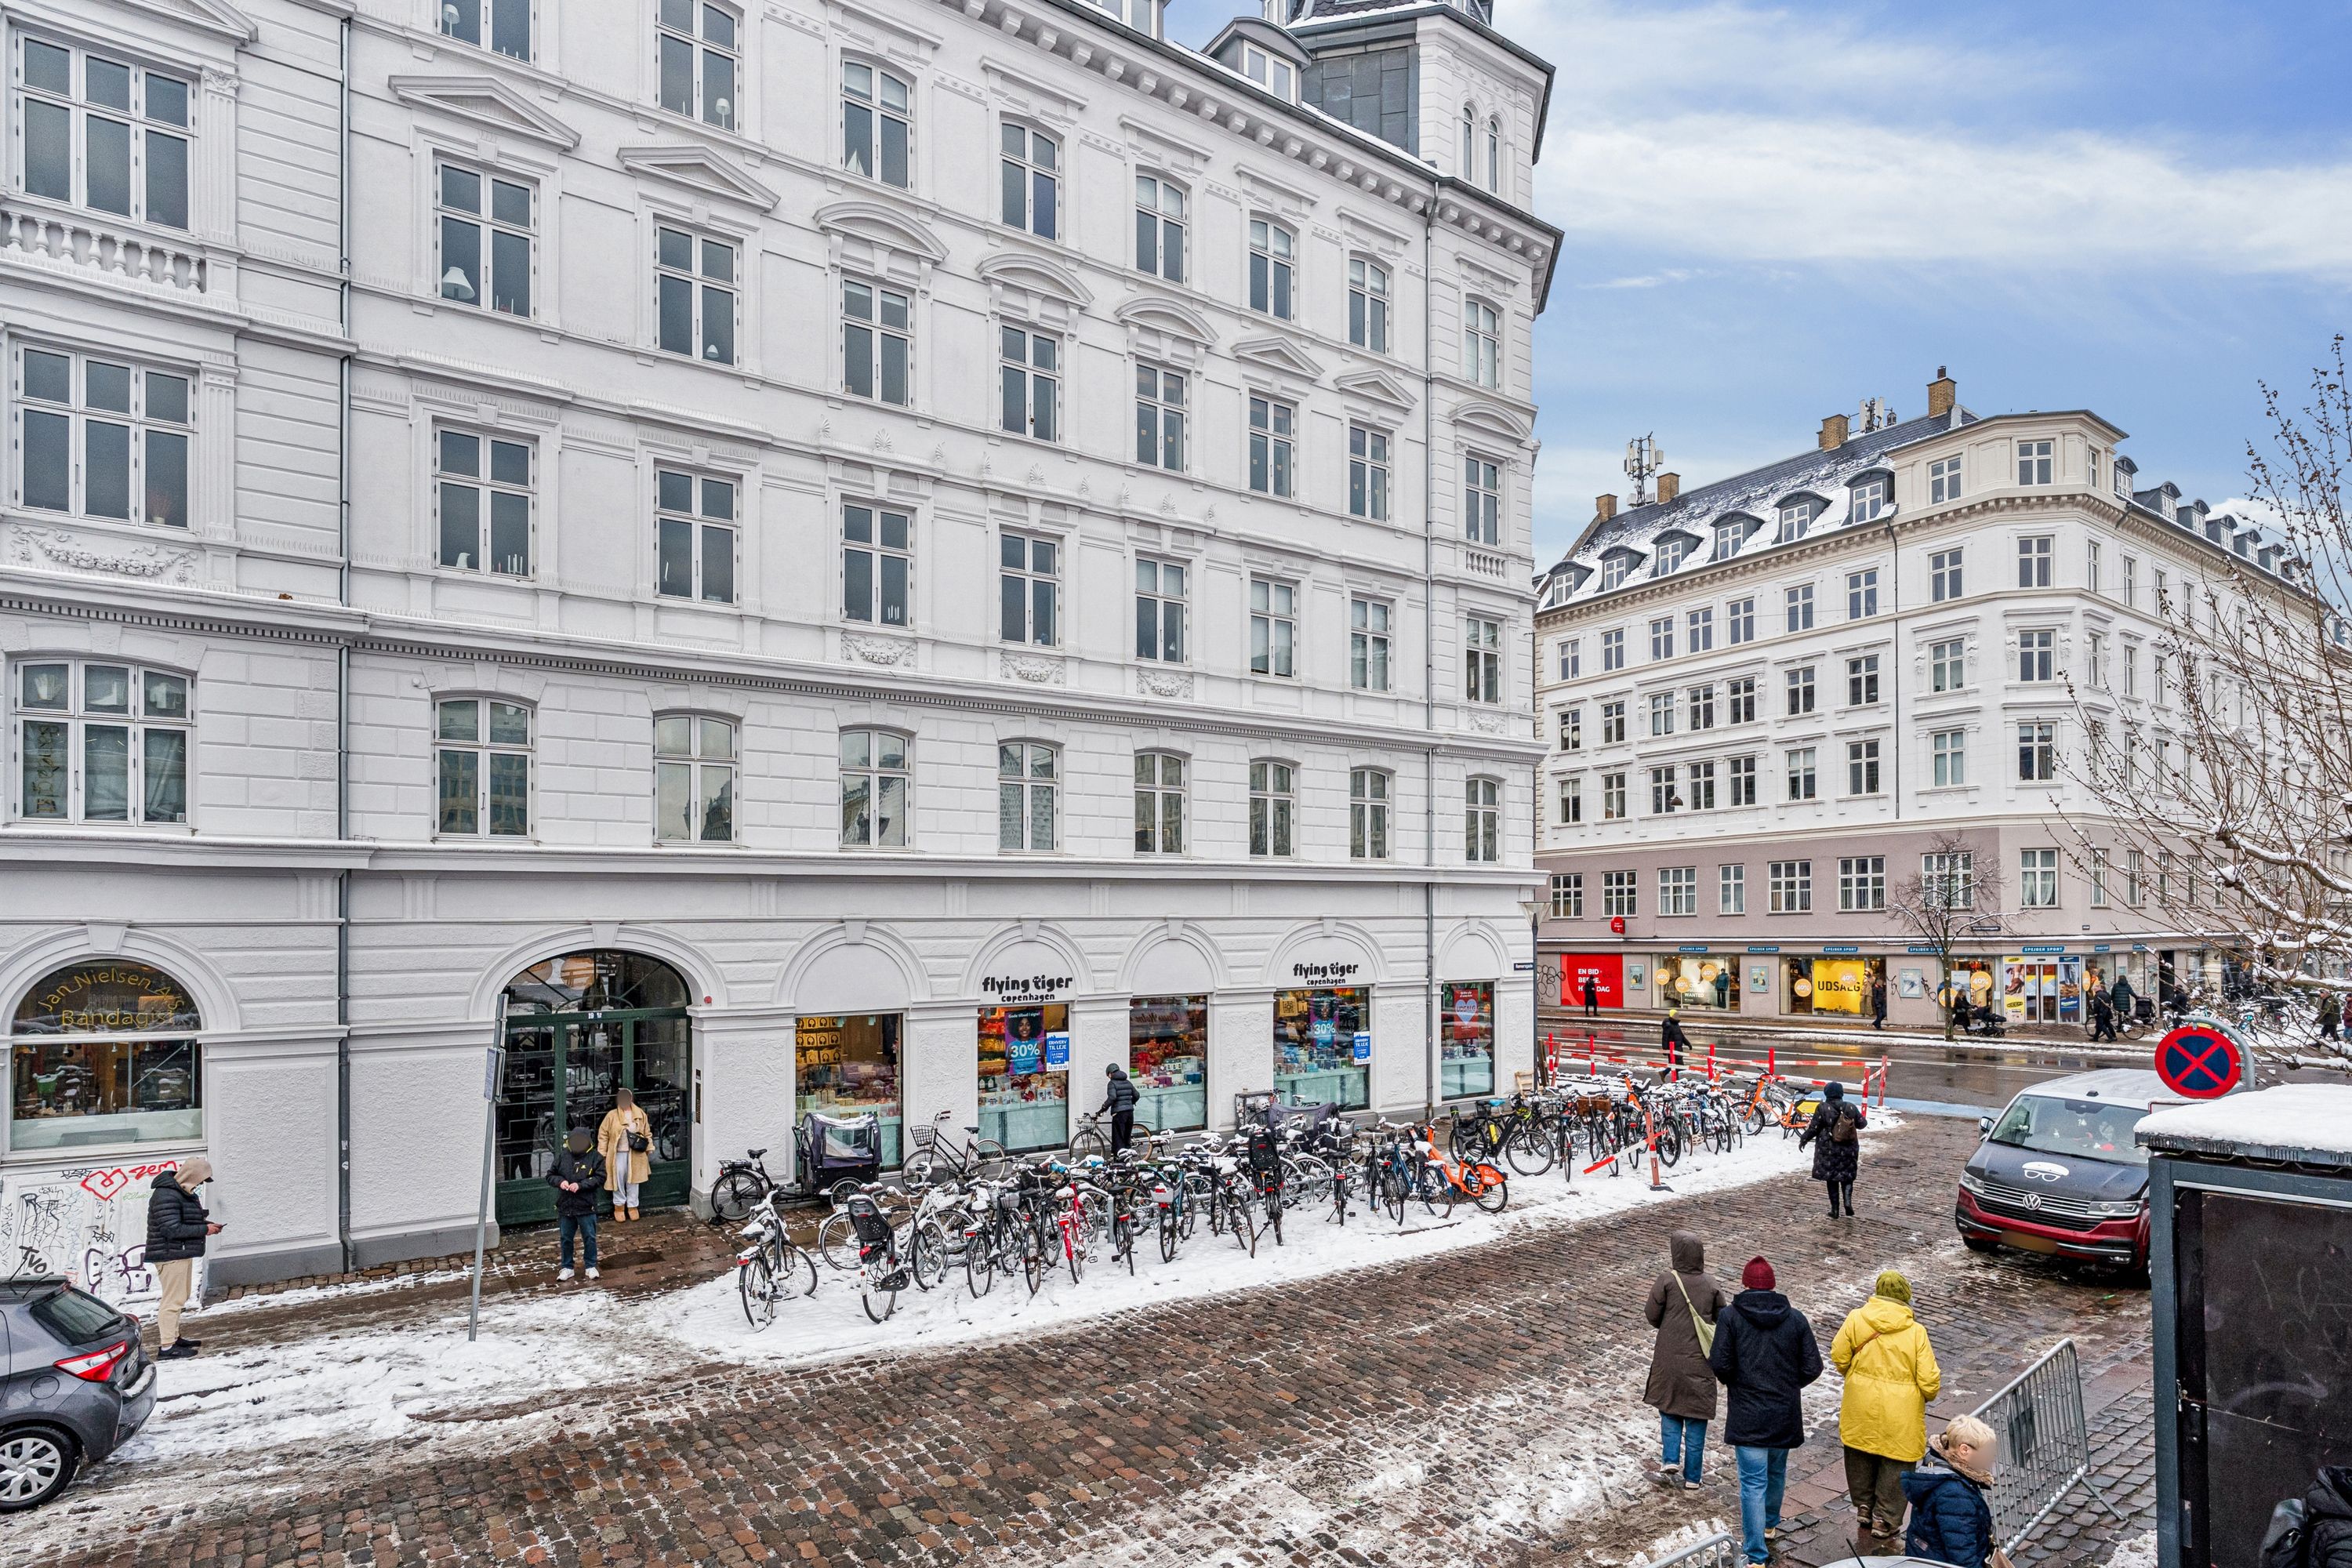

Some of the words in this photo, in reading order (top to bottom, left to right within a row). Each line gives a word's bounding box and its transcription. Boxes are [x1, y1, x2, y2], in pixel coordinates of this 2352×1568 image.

[1293, 963, 1327, 978] flying
[1330, 962, 1359, 977] tiger
[38, 985, 71, 1012] Jan
[74, 967, 151, 990] Nielsen
[982, 975, 1030, 995] flying
[1033, 975, 1073, 993] tiger
[1001, 993, 1055, 1003] copenhagen
[62, 1008, 176, 1029] Bandagist
[1315, 1022, 1336, 1034] 30%
[1011, 1044, 1040, 1058] 30%
